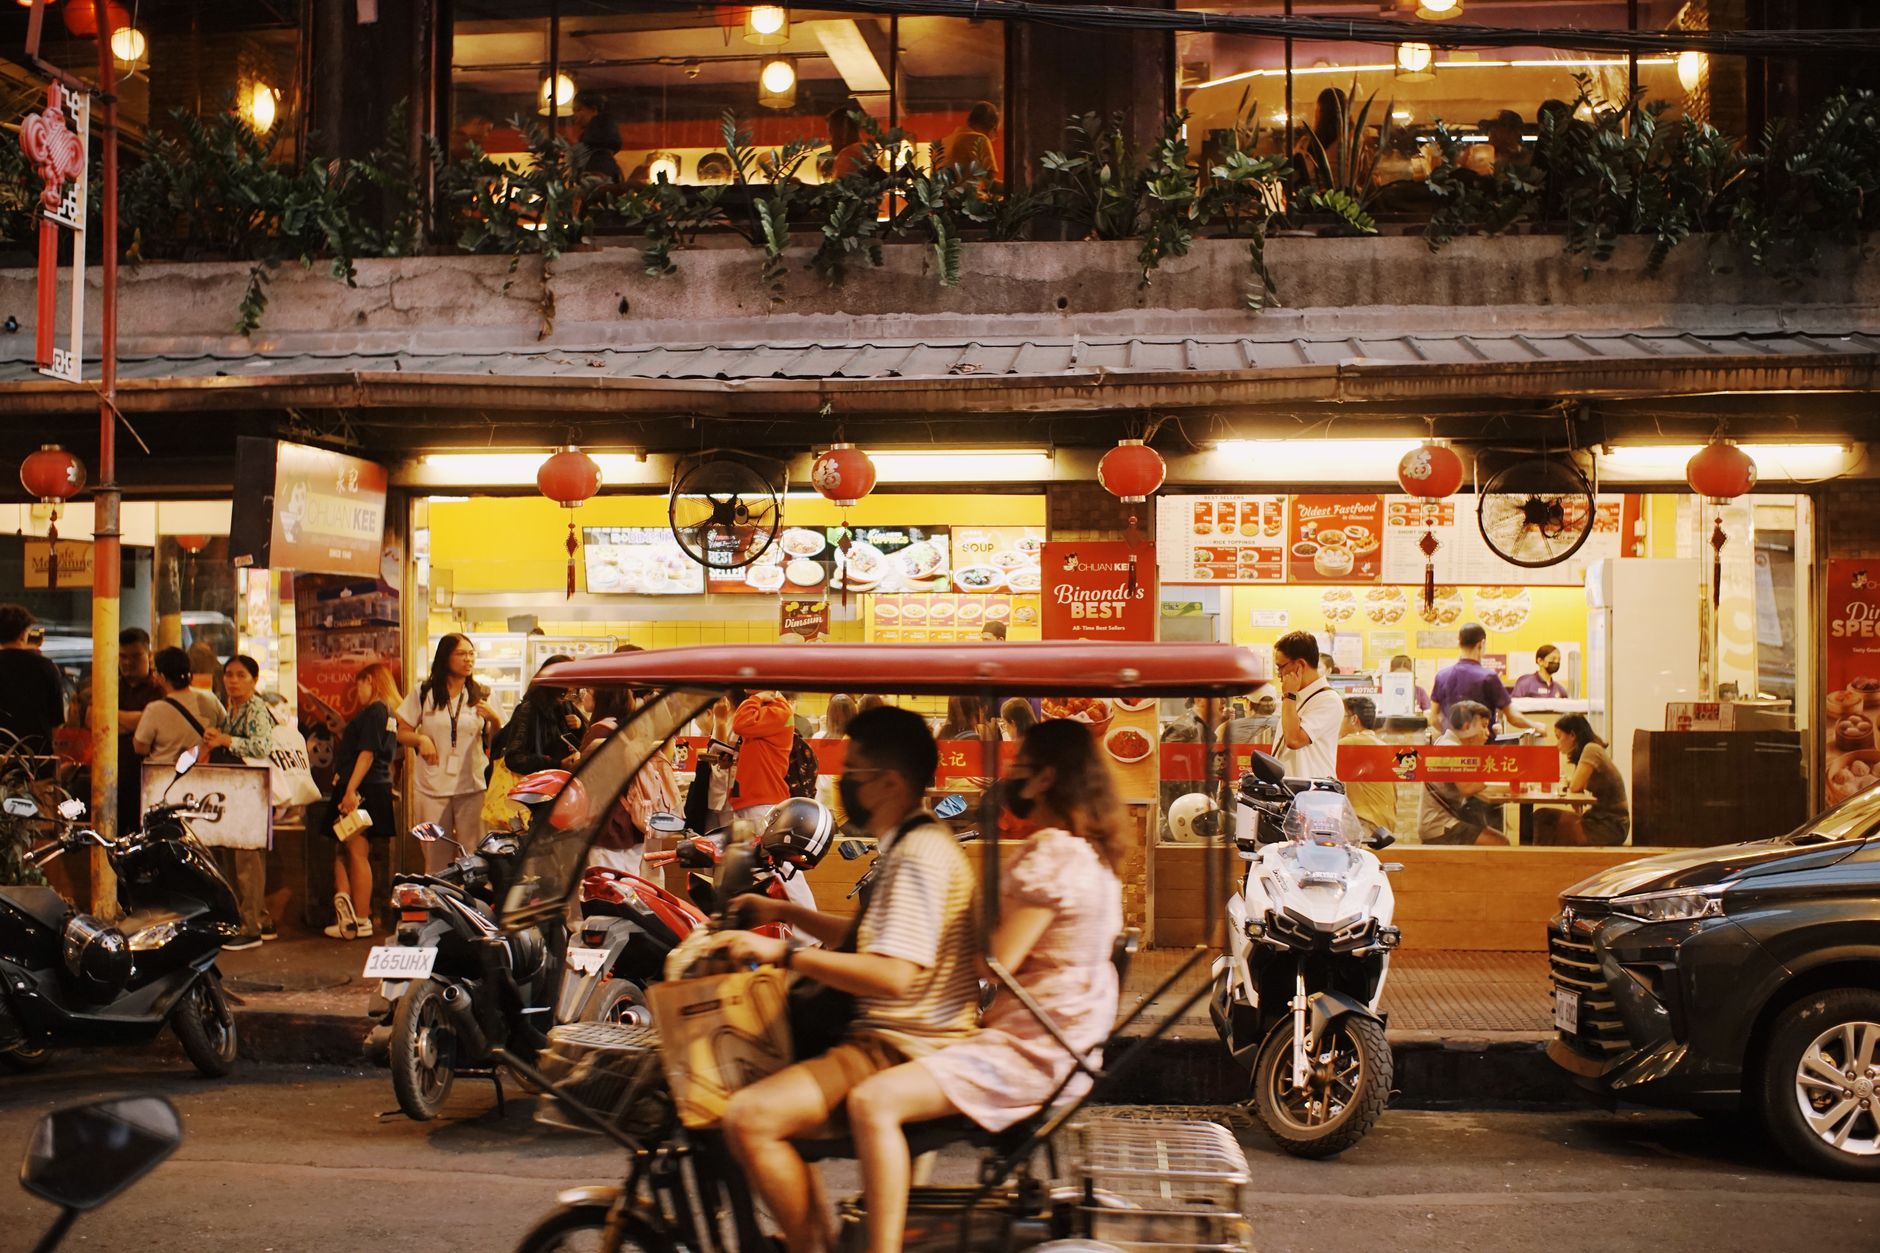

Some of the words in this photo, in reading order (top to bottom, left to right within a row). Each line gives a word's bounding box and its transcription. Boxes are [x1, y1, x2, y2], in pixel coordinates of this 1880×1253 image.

[1300, 506, 1331, 517] Oldest
[1333, 501, 1377, 515] Fastfood
[352, 507, 377, 533] KEE
[962, 543, 994, 553] SOUP
[707, 551, 733, 565] BEST
[1077, 563, 1113, 572] CHUAN
[1114, 563, 1135, 572] KE
[1070, 602, 1126, 619] BEST
[785, 616, 823, 628] Dimsum
[1483, 755, 1519, 774] 泉记
[368, 954, 431, 972] 165UHX
